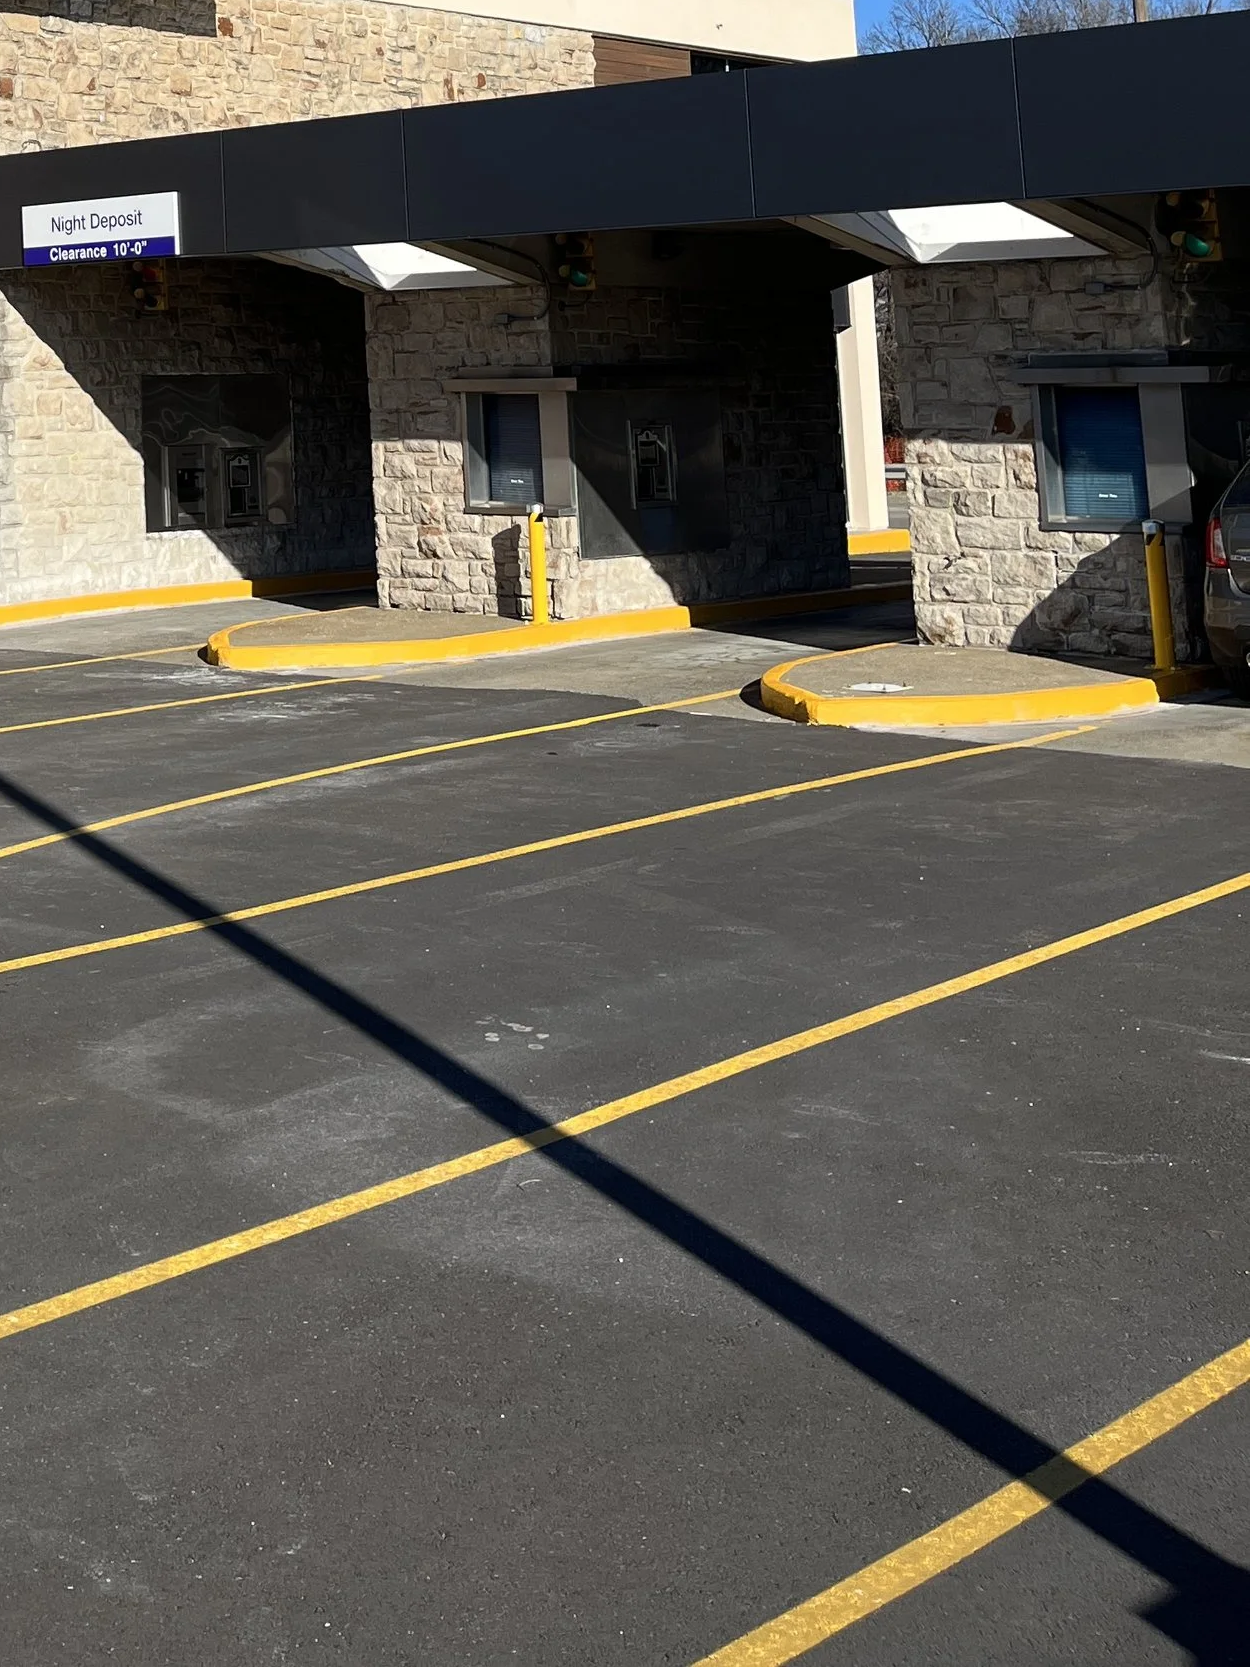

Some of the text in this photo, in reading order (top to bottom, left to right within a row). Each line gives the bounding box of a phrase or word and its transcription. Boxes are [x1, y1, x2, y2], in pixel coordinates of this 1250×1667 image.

[51, 209, 143, 235] Night Deposit
[50, 245, 107, 262] Clearance
